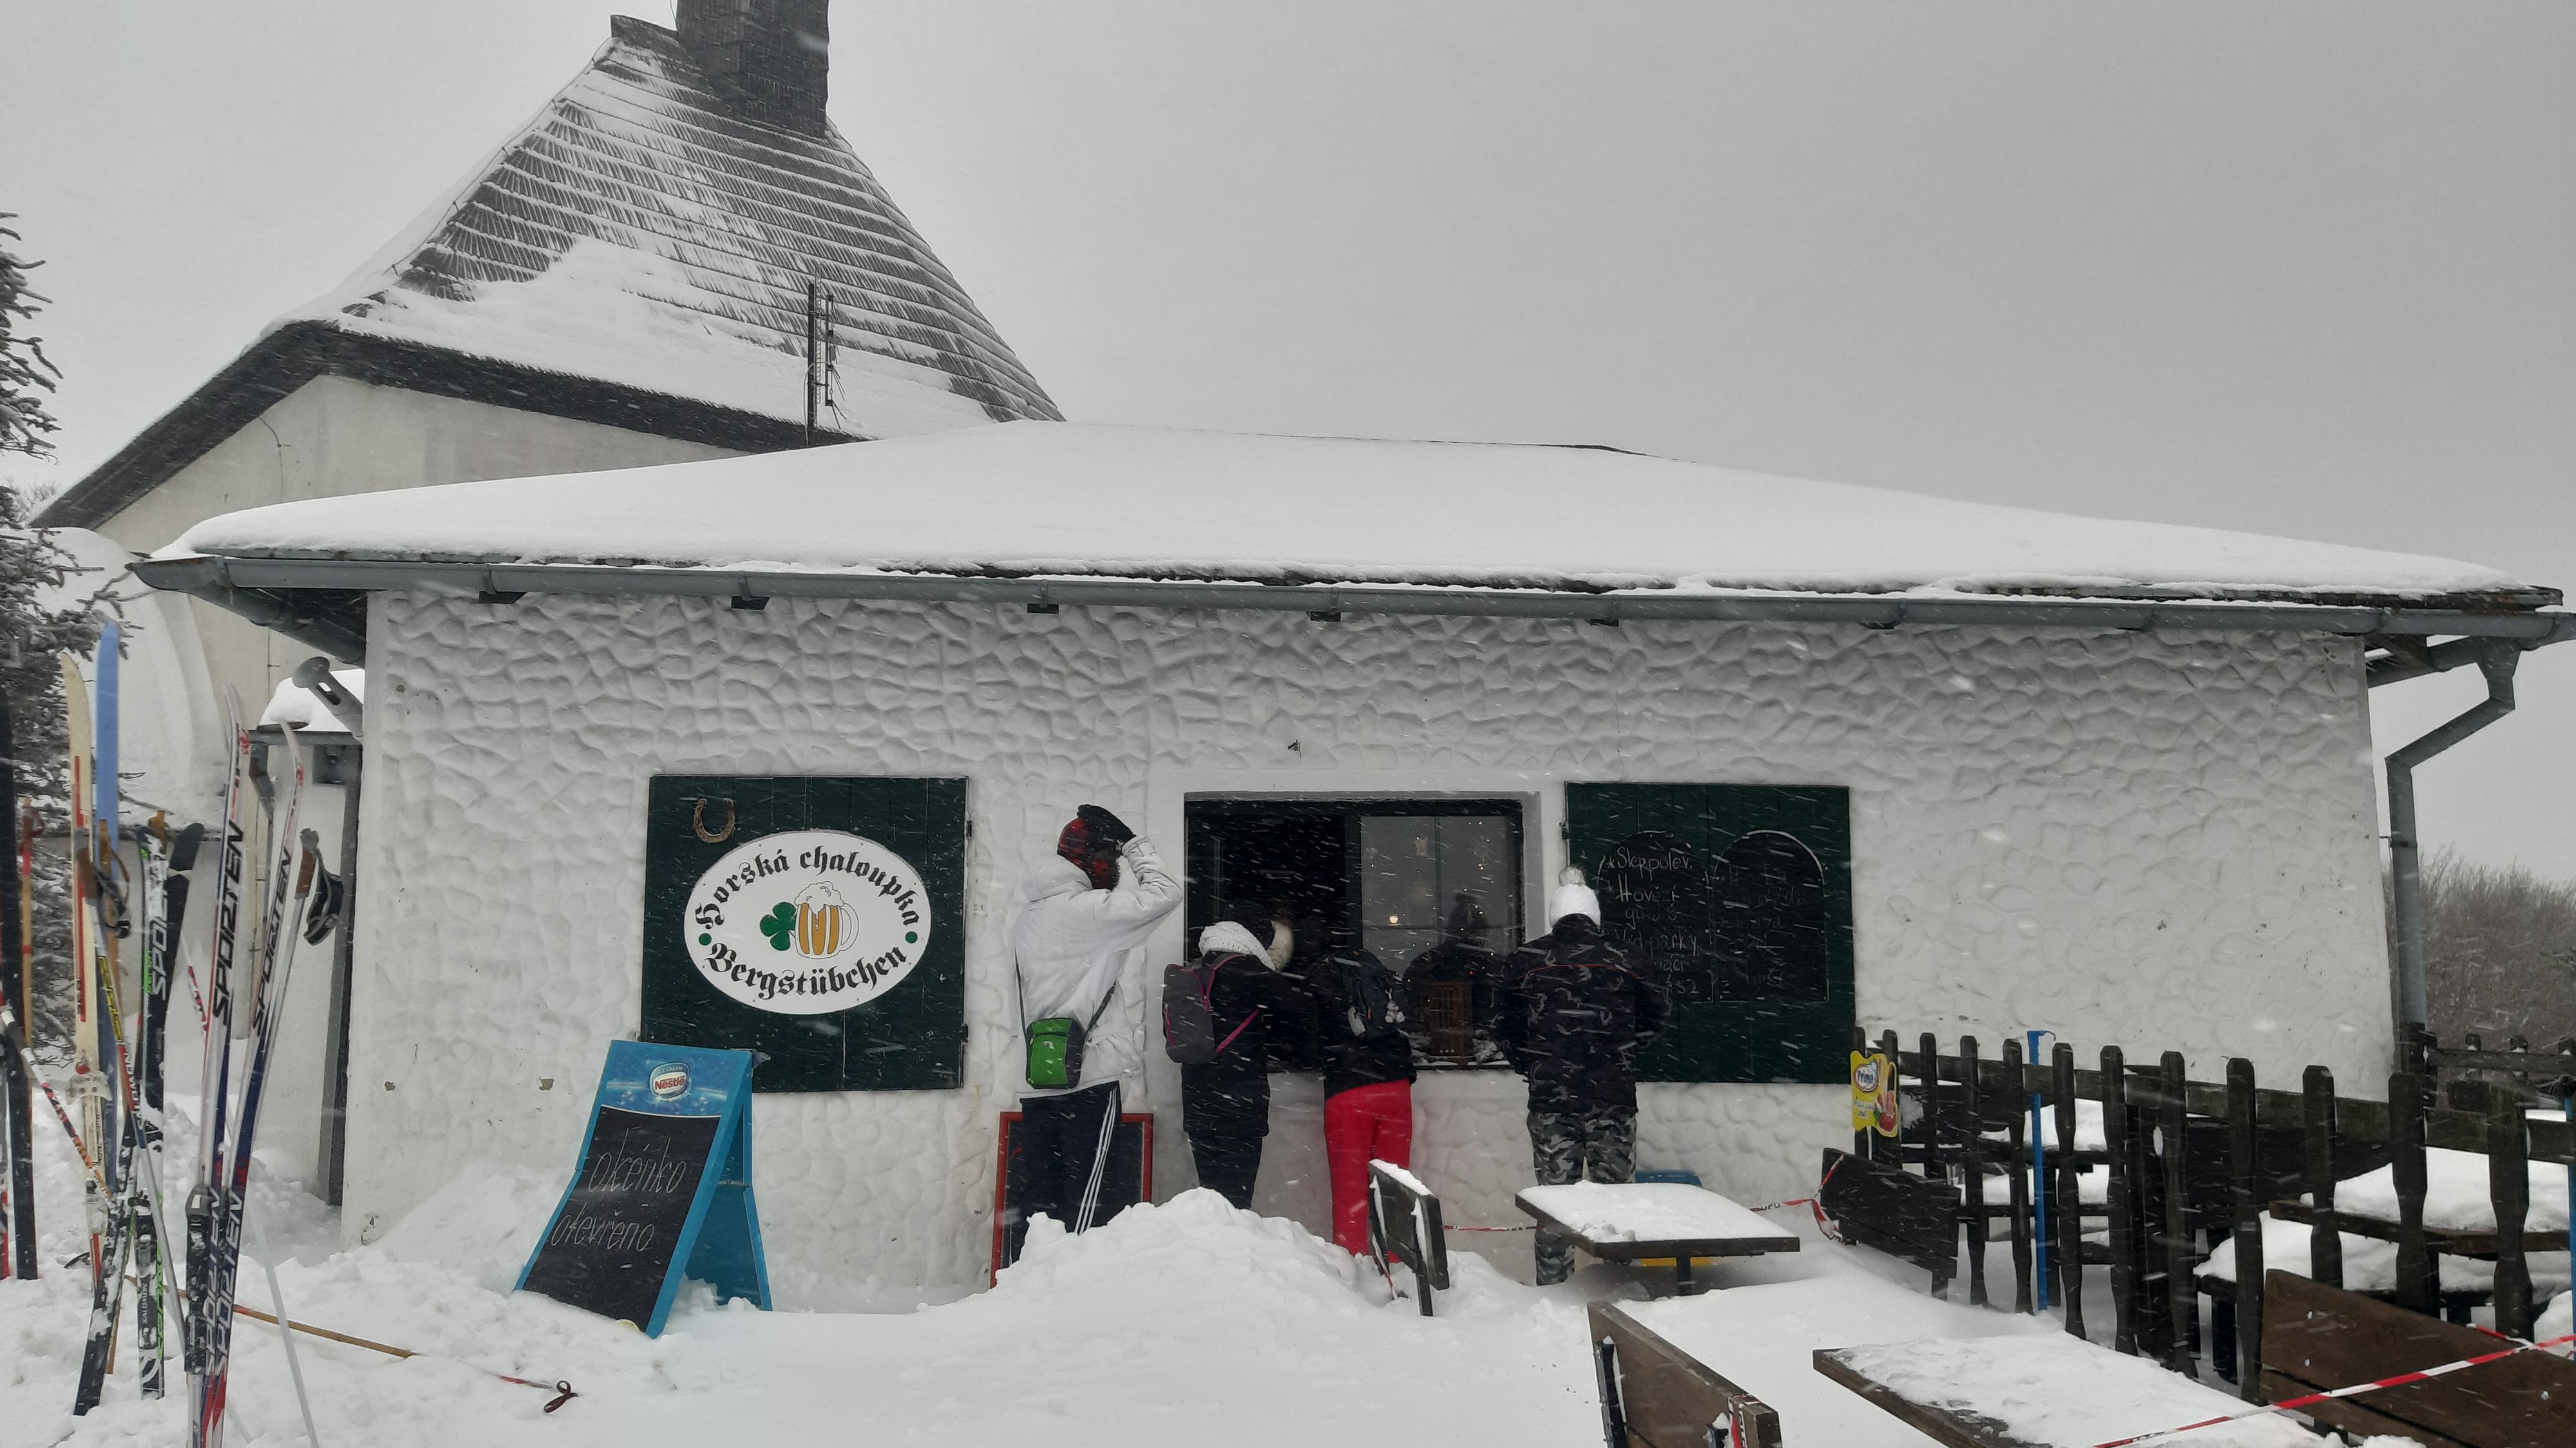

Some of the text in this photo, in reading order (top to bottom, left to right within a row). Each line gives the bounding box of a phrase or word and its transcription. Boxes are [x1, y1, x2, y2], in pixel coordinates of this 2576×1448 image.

[695, 845, 920, 929] Horská chaloupka
[213, 819, 243, 1027] SPORTEN
[705, 942, 907, 1000] Bergstübchen
[654, 1075, 685, 1091] Nestlé
[551, 1202, 655, 1252] otevřeno
